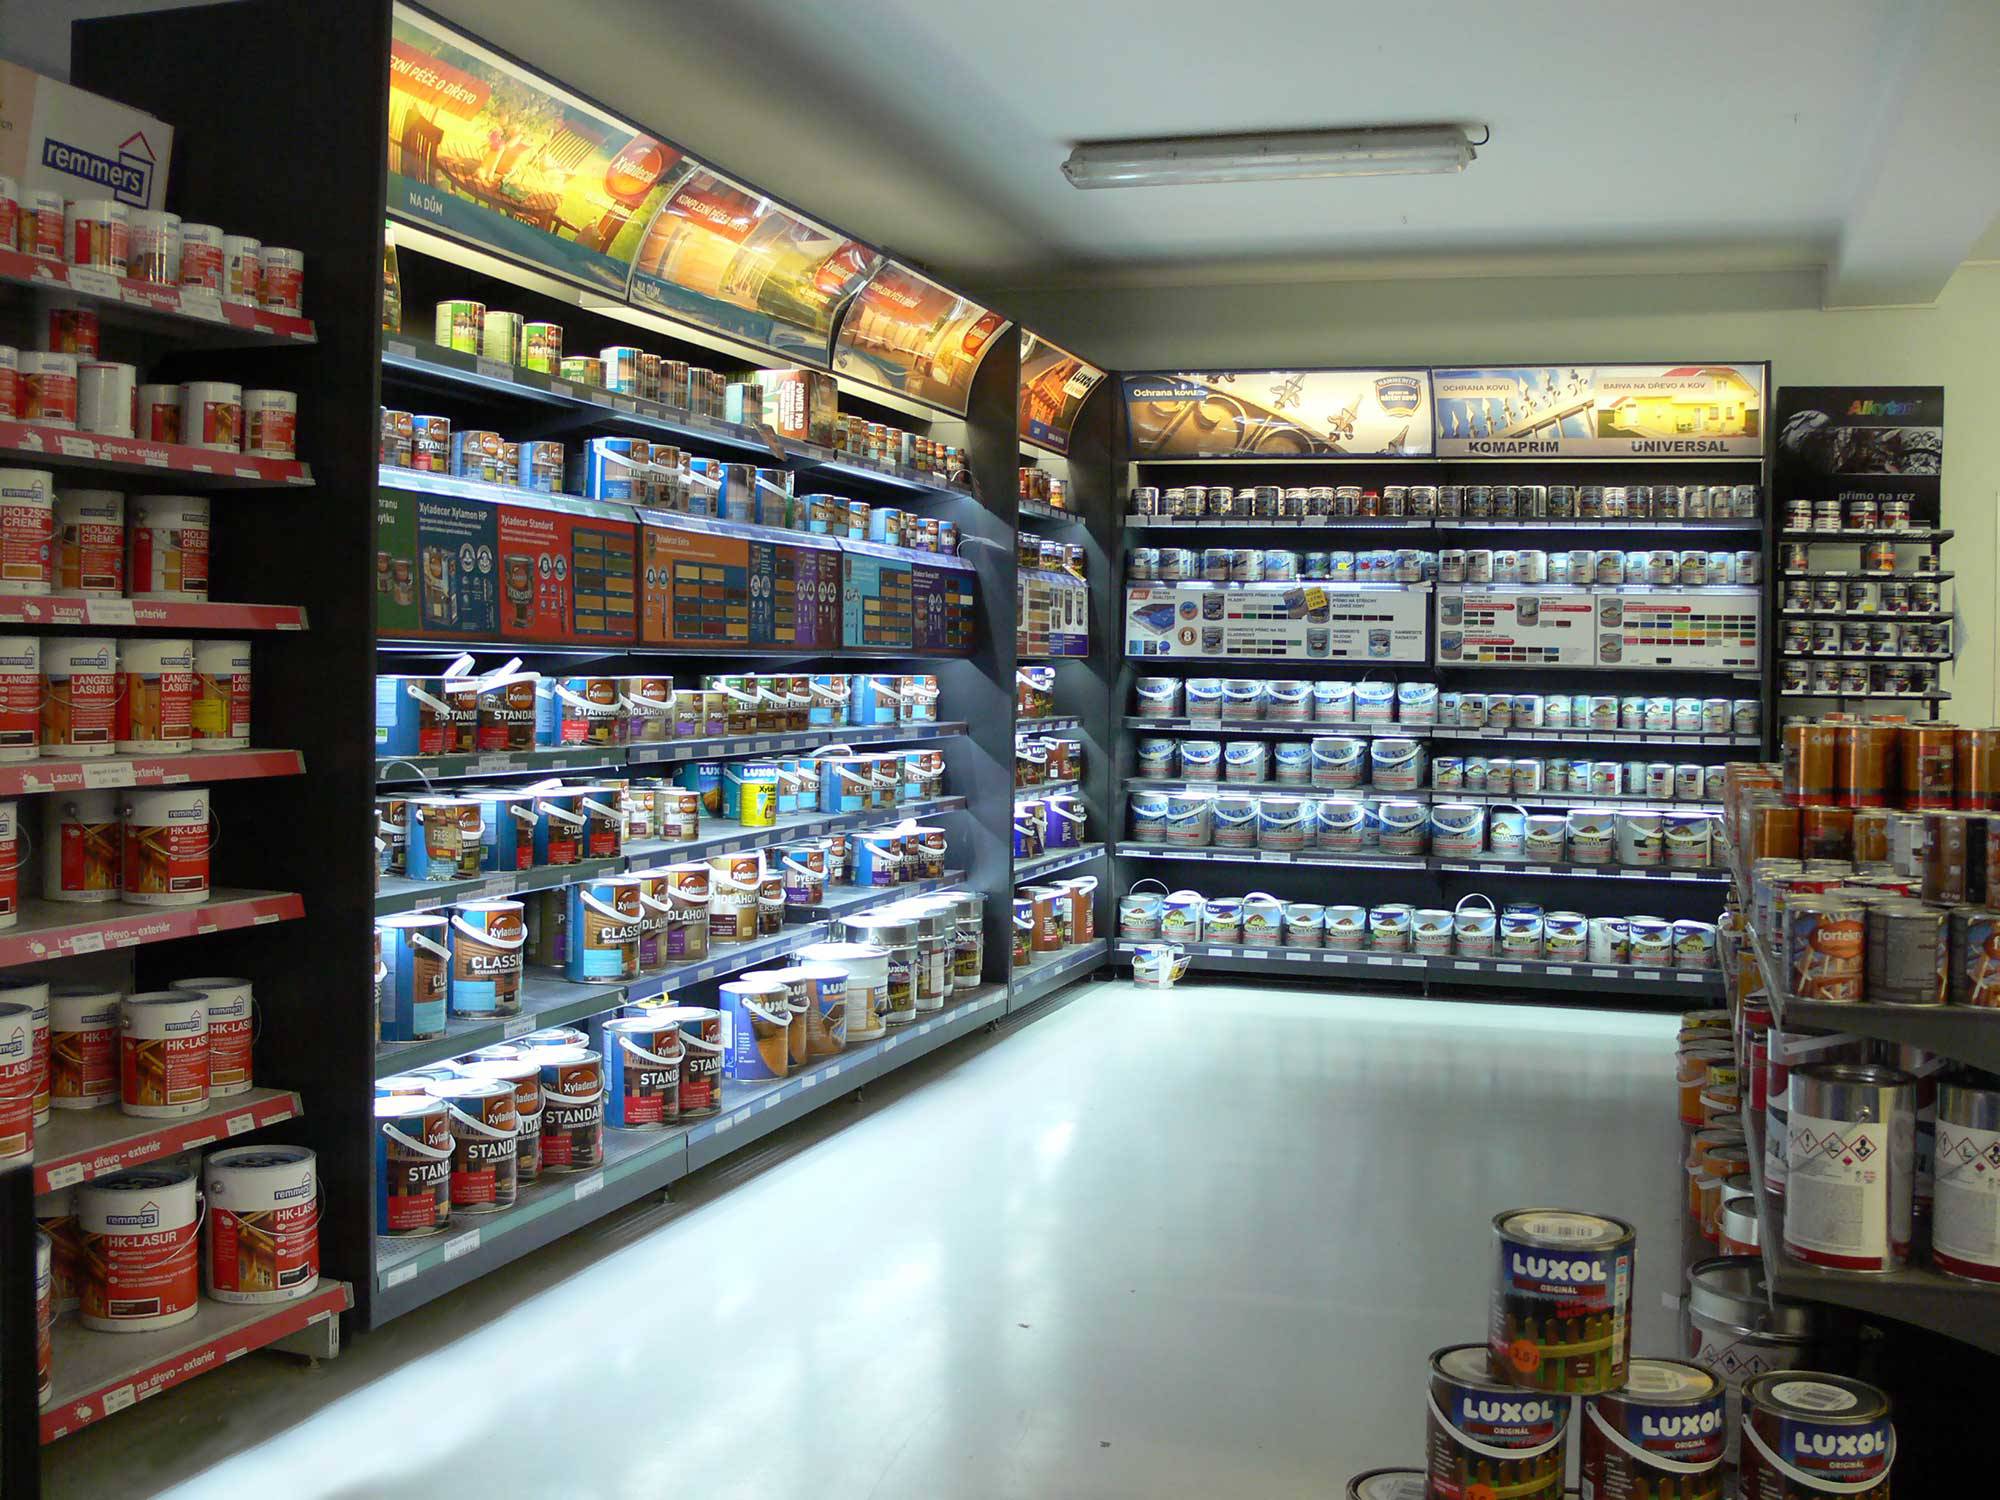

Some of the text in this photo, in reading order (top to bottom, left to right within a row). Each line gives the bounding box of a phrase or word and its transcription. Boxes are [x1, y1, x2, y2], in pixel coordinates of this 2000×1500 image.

[435, 80, 446, 91] O
[444, 83, 477, 104] DŘEVO
[45, 141, 144, 195] remmers
[409, 192, 443, 216] NA DŮM
[1133, 388, 1198, 398] Ochrana kovu
[1443, 384, 1485, 392] OCHRANA
[1648, 381, 1677, 389] DŘEVO
[795, 413, 804, 429] PAD
[1468, 441, 1560, 454] KOMAPRIM
[1631, 440, 1730, 453] UNIVERSAL
[1838, 491, 1916, 501] přímo na rez
[419, 503, 488, 521] Xyladecor Xylamon HP
[501, 514, 554, 531] Xyladecor Standard
[53, 605, 86, 619] Lazury
[71, 685, 106, 695] LASUR
[107, 1215, 154, 1225] remmers
[108, 1231, 178, 1247] HK-LASUR
[1512, 1252, 1608, 1282] LUXOL
[1463, 1397, 1554, 1424] LUXOL
[1794, 1430, 1886, 1457] LUXOL
